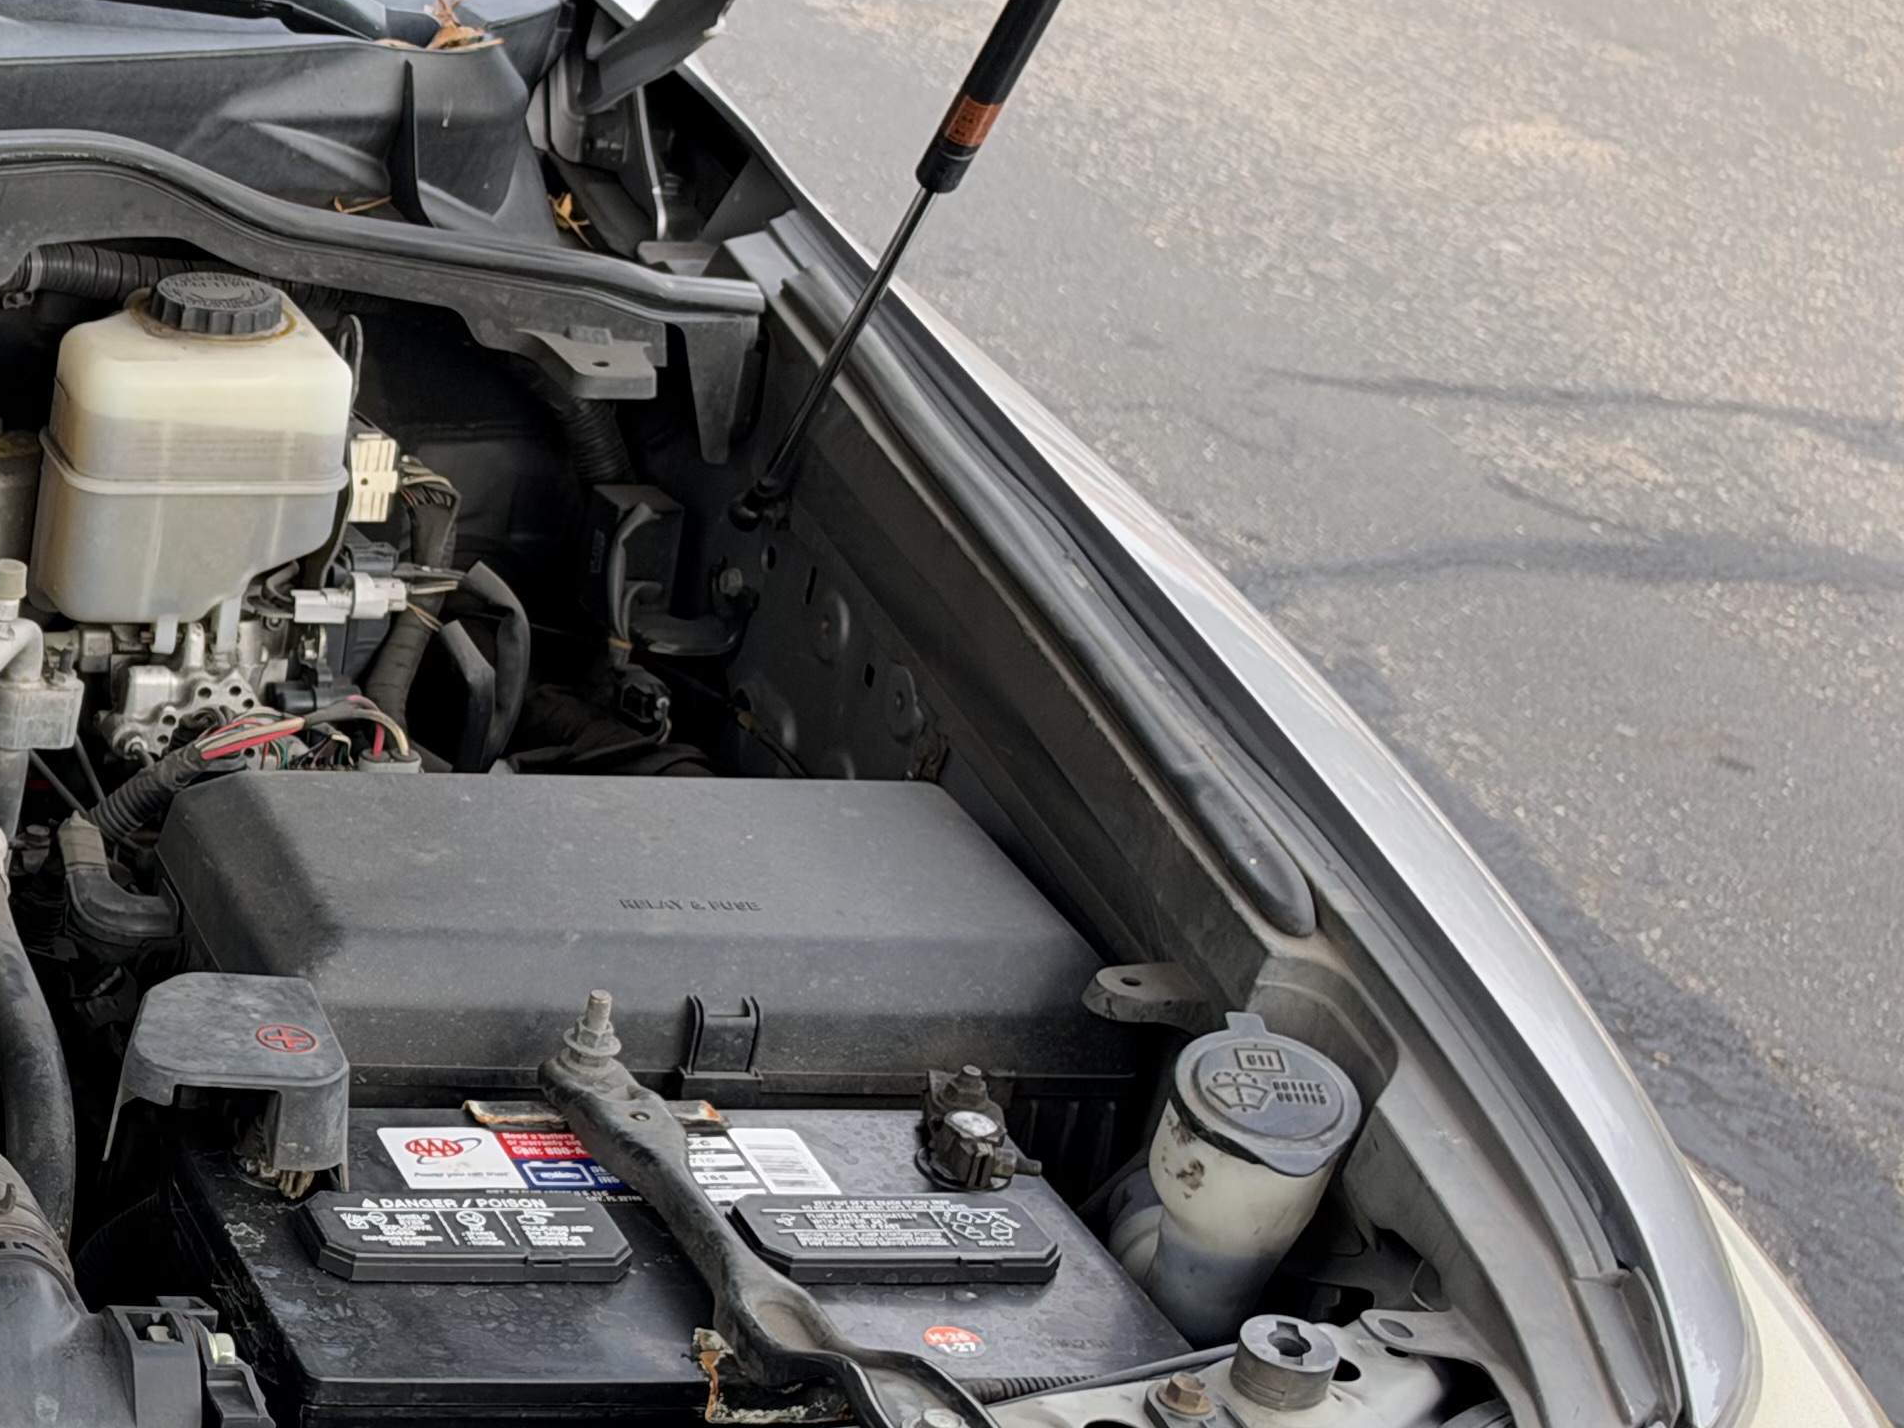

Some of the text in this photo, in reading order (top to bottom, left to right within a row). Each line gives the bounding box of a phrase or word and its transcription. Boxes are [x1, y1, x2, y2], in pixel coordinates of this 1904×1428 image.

[619, 898, 683, 911] RELAY
[411, 1139, 463, 1157] AAA
[379, 1199, 458, 1209] DANGER
[476, 1199, 548, 1209] POISON
